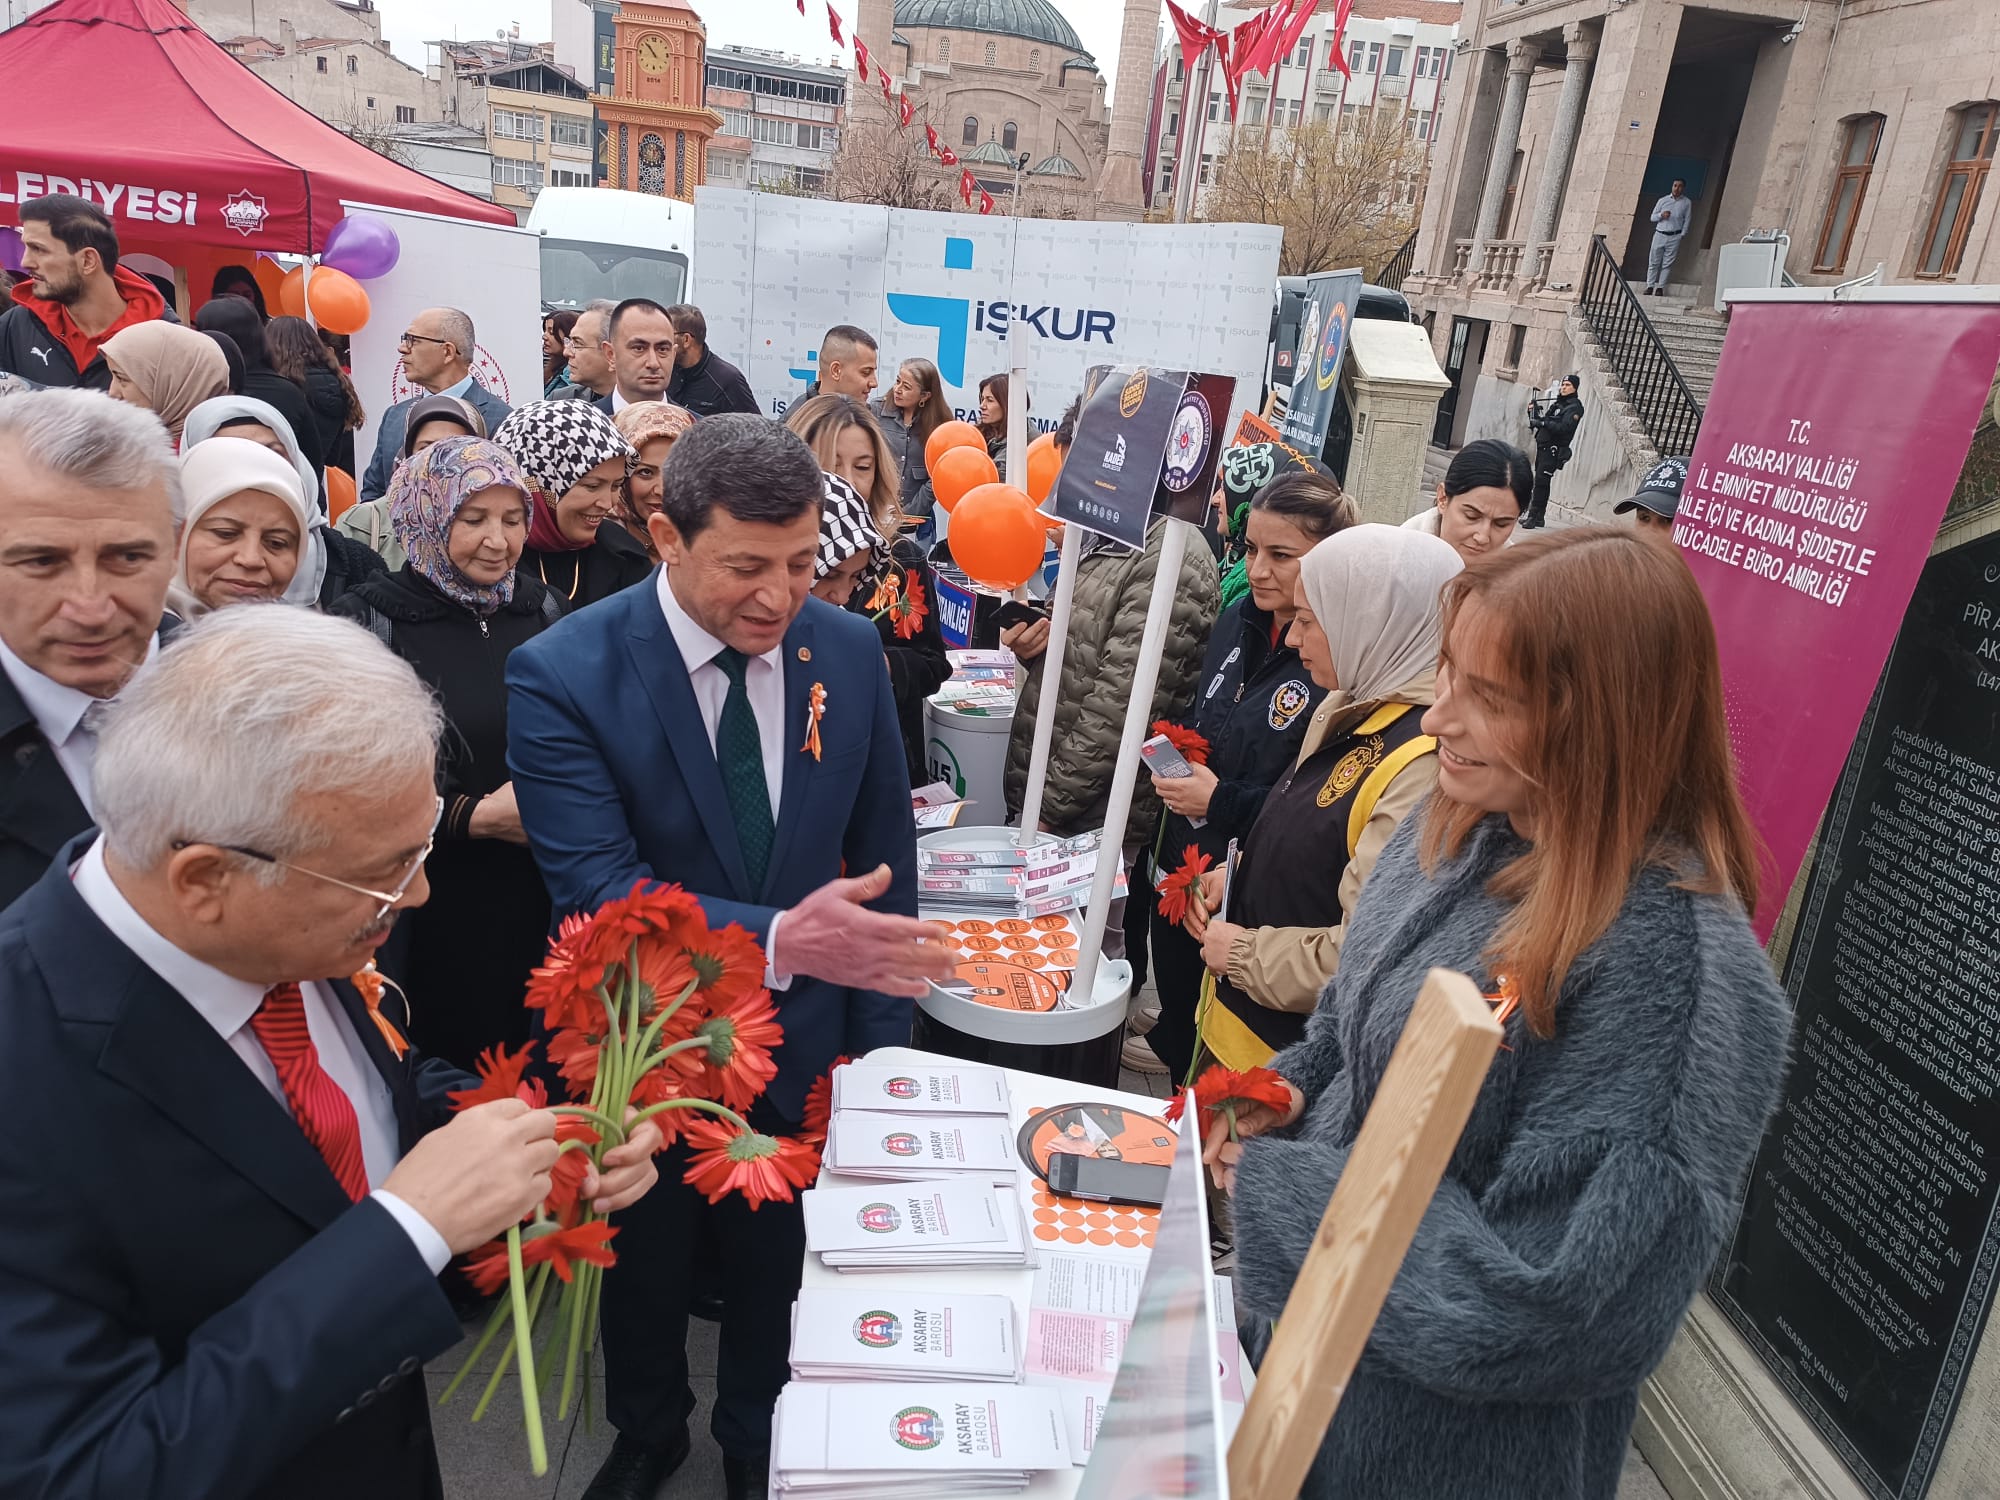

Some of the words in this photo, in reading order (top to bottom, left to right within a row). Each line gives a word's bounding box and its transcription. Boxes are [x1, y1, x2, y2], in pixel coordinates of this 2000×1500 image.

[0, 170, 197, 225] EDİYESİ
[1786, 418, 1811, 446] T.C.
[1726, 443, 1795, 477] AKSARAY
[1795, 454, 1860, 492] VALİLİĞİ
[1696, 463, 1712, 491] İL
[1711, 470, 1773, 508] EMNİYET
[1772, 487, 1869, 533] MÜDÜRLÜĞÜ
[1677, 491, 1705, 522] AİLE
[1704, 498, 1726, 530] İÇİ
[1724, 508, 1743, 533] VE
[1742, 514, 1797, 551] KADINA
[1796, 525, 1878, 577] ŞİDDETLE
[1671, 523, 1743, 567] MÜCADELE
[1742, 547, 1784, 582] BÜRO
[1781, 561, 1853, 608] AMİRLİĞİ
[1963, 601, 1992, 629] PÎR
[1883, 756, 1937, 792] Aksaray'da
[1891, 725, 1948, 760] Anadolu'da
[1950, 752, 1996, 783] yetişmiş
[1891, 740, 1910, 760] biri
[1910, 752, 1932, 771] olan
[1934, 761, 1951, 779] Pîr
[1950, 770, 1968, 788] Ali
[1895, 782, 1927, 805] mezar
[1928, 795, 1982, 834] kitabesine
[1899, 799, 1952, 838] Bahaeddin
[1858, 830, 1899, 862] Talebesi
[1899, 855, 1971, 905] Abdurrahman
[1913, 845, 1930, 862] Ali
[1930, 856, 1975, 888] şeklinde
[1932, 837, 1955, 856] dair
[1869, 873, 1919, 912] tanındığını
[1869, 853, 1888, 876] halk
[1889, 870, 1934, 902] arasında
[1934, 893, 1970, 924] Sultan
[1971, 915, 1990, 934] Pir
[1842, 907, 1888, 947] Bünyamin
[1938, 975, 1971, 1003] sonra
[1844, 890, 1877, 921] Bıçakçı
[1879, 911, 1907, 940] Ömer
[1908, 932, 1953, 971] Dede'nin
[1905, 914, 1953, 951] yolundan
[1834, 922, 1881, 959] makamına
[1881, 954, 1917, 985] geçmiş
[1919, 979, 1931, 995] ve
[1932, 988, 1993, 1038] Aksaray'da
[1836, 938, 1903, 993] faaliyetlerinde
[1975, 1036, 1995, 1057] Pir
[1834, 974, 1866, 1002] olduğu
[1867, 996, 1879, 1012] ve
[1880, 1008, 1899, 1027] ona
[1900, 1023, 1919, 1042] çok
[1920, 1037, 1955, 1068] sayıda
[1956, 1060, 1993, 1098] kişinin
[1838, 990, 1870, 1023] intisap
[1870, 1018, 1896, 1043] ettiği
[1888, 996, 1917, 1022] geniş
[1919, 1013, 1934, 1032] bir
[1935, 1028, 1973, 1063] nüfuza
[929, 1076, 941, 1102] AKSARAY
[944, 1077, 953, 1101] BAROSU
[1805, 1023, 1821, 1045] ilim
[1822, 1039, 1858, 1075] yolunda
[1859, 1067, 1887, 1098] üstün
[1887, 1092, 1943, 1146] derecelere
[1944, 1140, 1988, 1183] ulaşmış
[1816, 1013, 1832, 1032] Pir
[1830, 1026, 1846, 1043] Ali
[1844, 1036, 1874, 1068] Sultan
[1922, 1100, 1971, 1145] tasavvuf
[1970, 1140, 1984, 1158] ve
[930, 1130, 944, 1160] AKSARAY
[945, 1132, 956, 1158] BAROSU
[1803, 1039, 1830, 1070] büyük
[1830, 1062, 1845, 1081] bir
[1878, 1104, 1920, 1147] Osmanlı
[1921, 1138, 1980, 1197] hükümdarı
[1814, 1087, 1853, 1128] Seferine
[1853, 1124, 1899, 1170] çıktığında
[1900, 1162, 1917, 1183] Pir
[1847, 1096, 1878, 1131] Sultan
[1878, 1123, 1929, 1175] Süleyman
[1929, 1165, 1952, 1196] İran
[1785, 1095, 1826, 1141] İstanbul'a
[1826, 1136, 1852, 1168] davet
[1892, 1198, 1926, 1235] Ancak
[1926, 1227, 1945, 1250] Pir
[1944, 1246, 1963, 1268] Ali
[1801, 1095, 1850, 1145] Aksaray'da
[1849, 1138, 1884, 1176] ziyaret
[1884, 1170, 1912, 1202] etmiş
[1913, 1196, 1927, 1215] ve
[1927, 1211, 1950, 1236] onu
[908, 1198, 926, 1234] AKSARAY
[923, 1199, 939, 1231] BAROSU
[1821, 1153, 1867, 1201] padişahın
[1867, 1192, 1881, 1213] bu
[1881, 1206, 1920, 1249] isteğini
[1918, 1244, 1942, 1271] geri
[1765, 1170, 1780, 1188] Pir
[1778, 1184, 1792, 1202] Ali
[1789, 1196, 1819, 1231] Sultan
[1818, 1225, 1843, 1254] 1539
[1843, 1250, 1873, 1287] yılında
[1873, 1283, 1931, 1346] Aksaray'da
[1774, 1198, 1795, 1226] vefat
[1832, 1256, 1868, 1302] Türbesi
[1868, 1294, 1915, 1349] Taşpazar
[1775, 1217, 1831, 1282] Mahallesinde
[913, 1309, 927, 1353] AKSARAY
[931, 1313, 942, 1351] BAROSU
[1776, 1315, 1813, 1360] AKSARAY
[1813, 1356, 1849, 1403] VALİLİĞİ
[955, 1403, 973, 1454] AKSARAY
[973, 1406, 989, 1451] BAROSU
